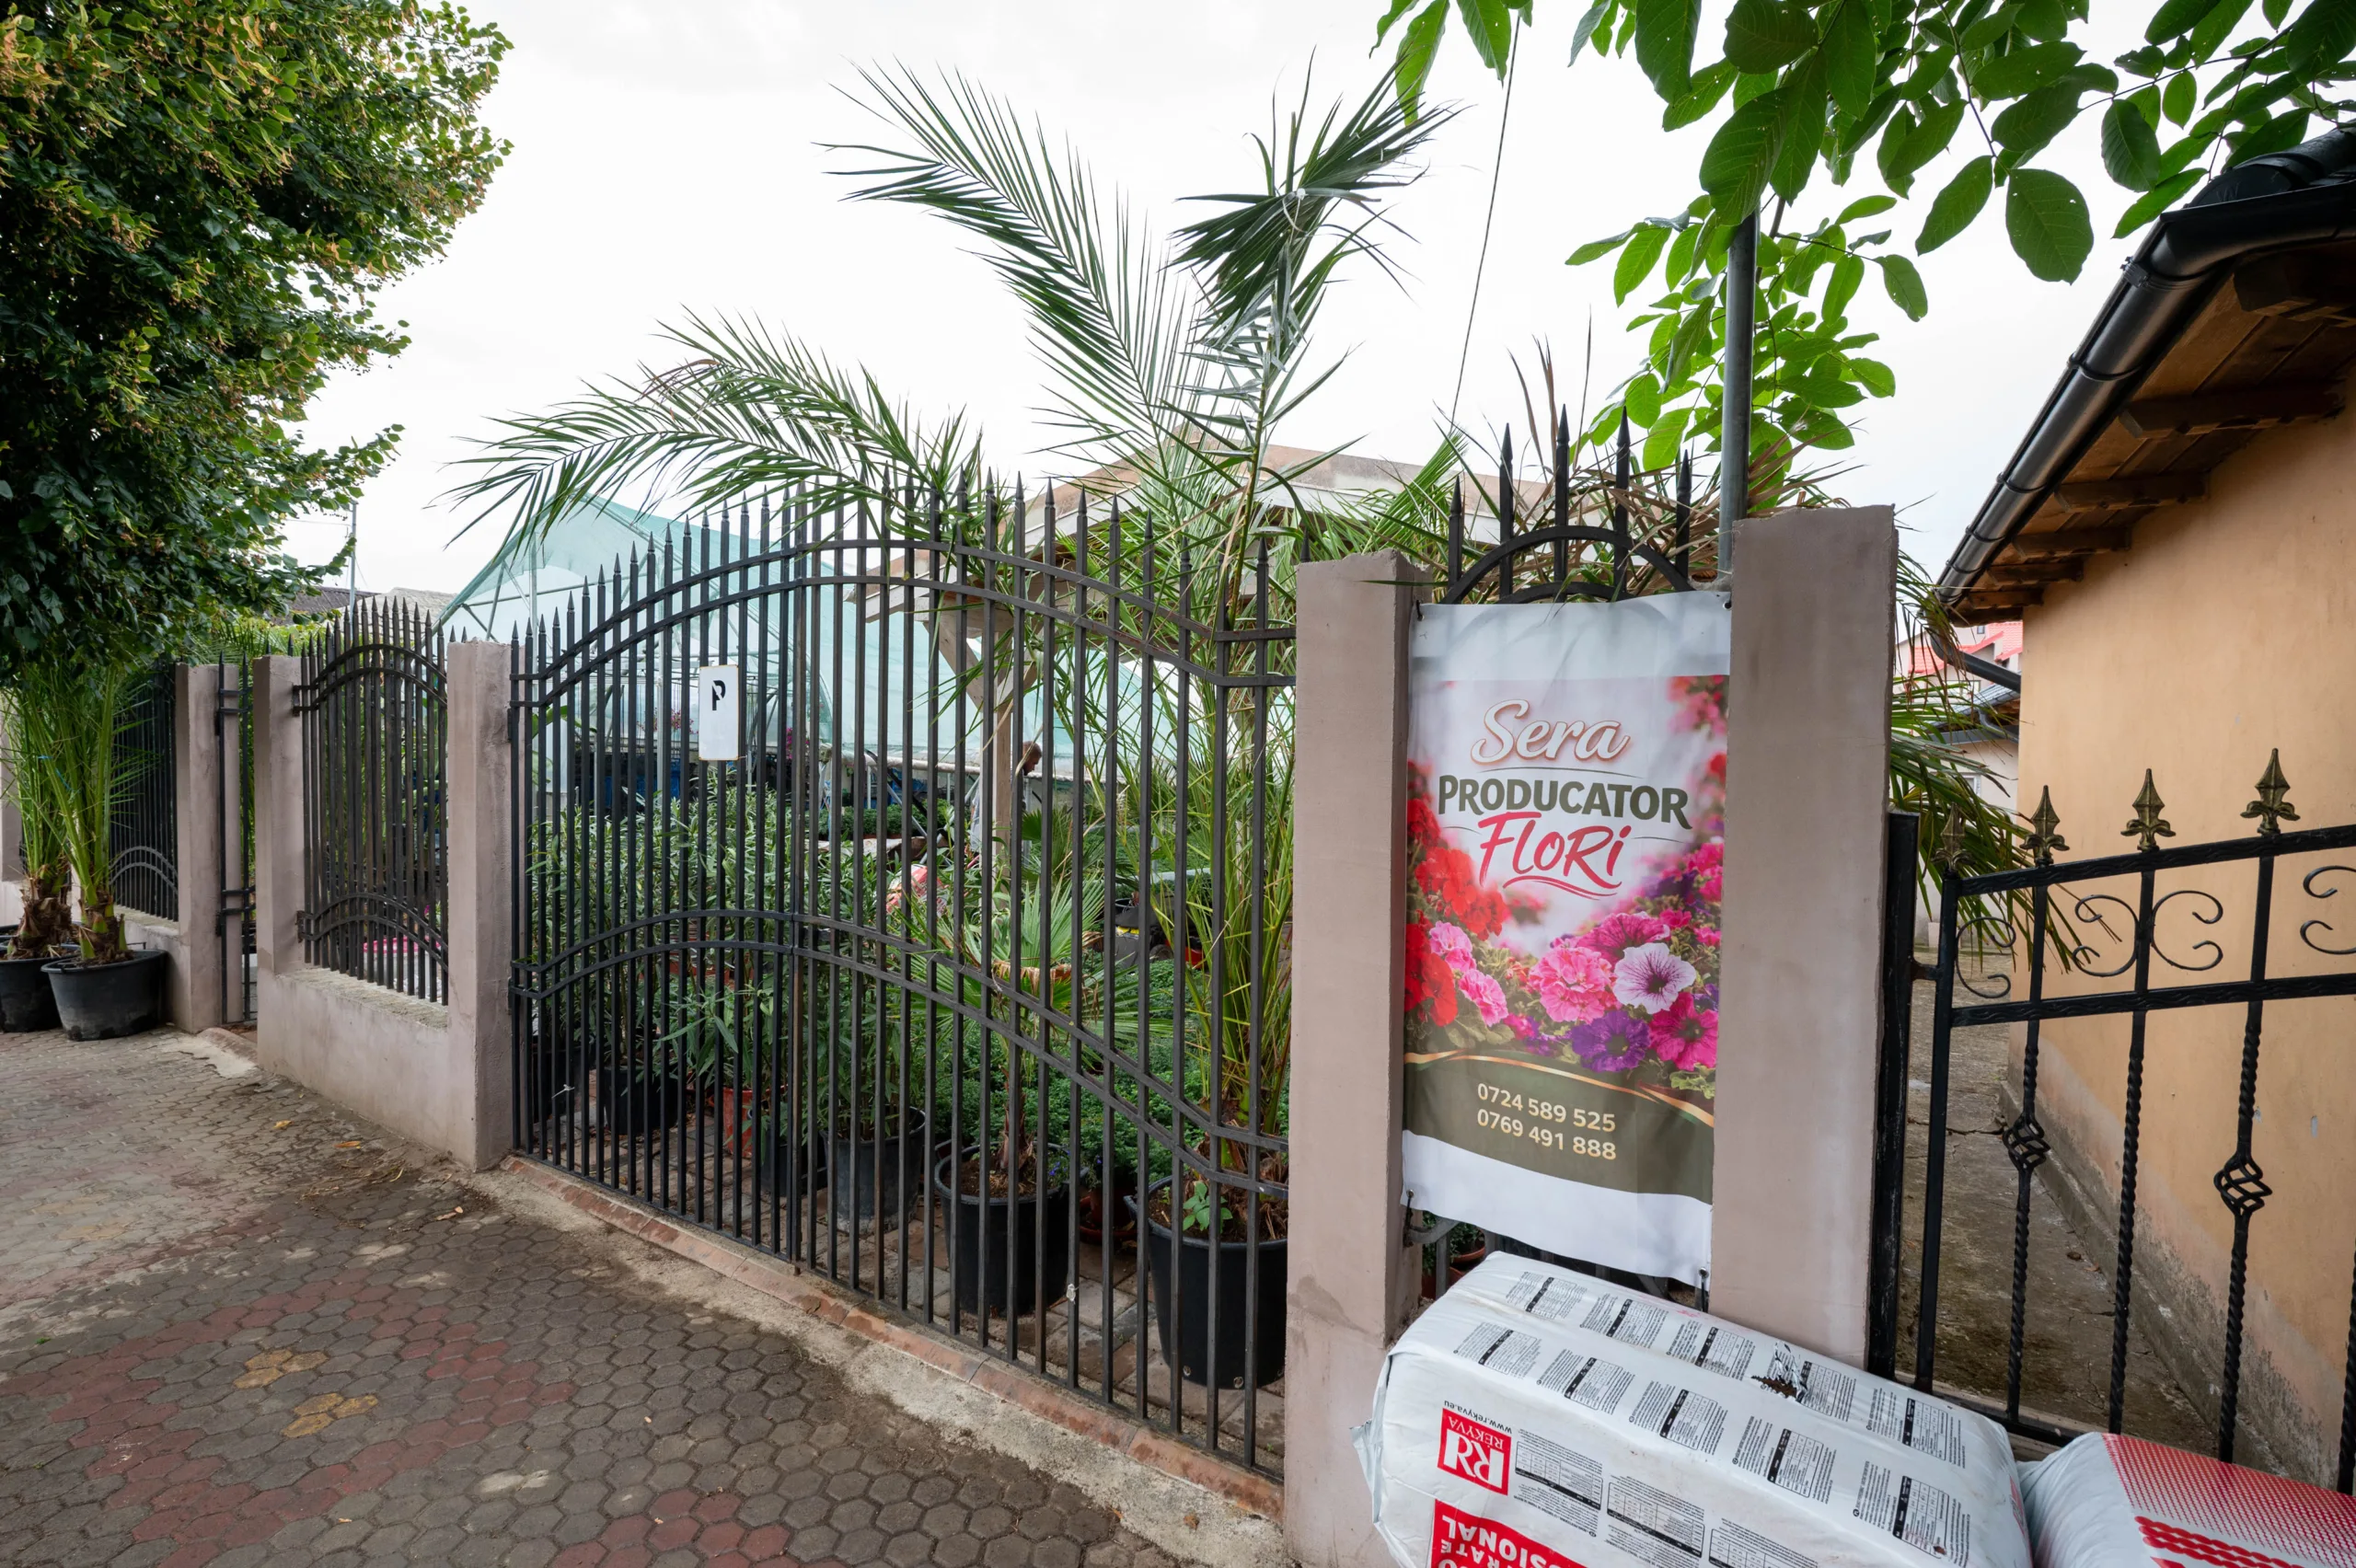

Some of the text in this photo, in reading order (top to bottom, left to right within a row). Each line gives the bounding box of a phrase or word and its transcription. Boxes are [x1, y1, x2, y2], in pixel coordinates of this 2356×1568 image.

[711, 679, 726, 711] P
[1471, 698, 1631, 765] Sera
[1438, 775, 1693, 830] PRODUCATOR
[1477, 1083, 1616, 1133] 0724 589 525
[1477, 1109, 1617, 1160] 0769 491 888
[1444, 1400, 1512, 1435] www.rekyva.eu
[1440, 1539, 1511, 1568] RATE
[1442, 1515, 1561, 1568] SIONAL
